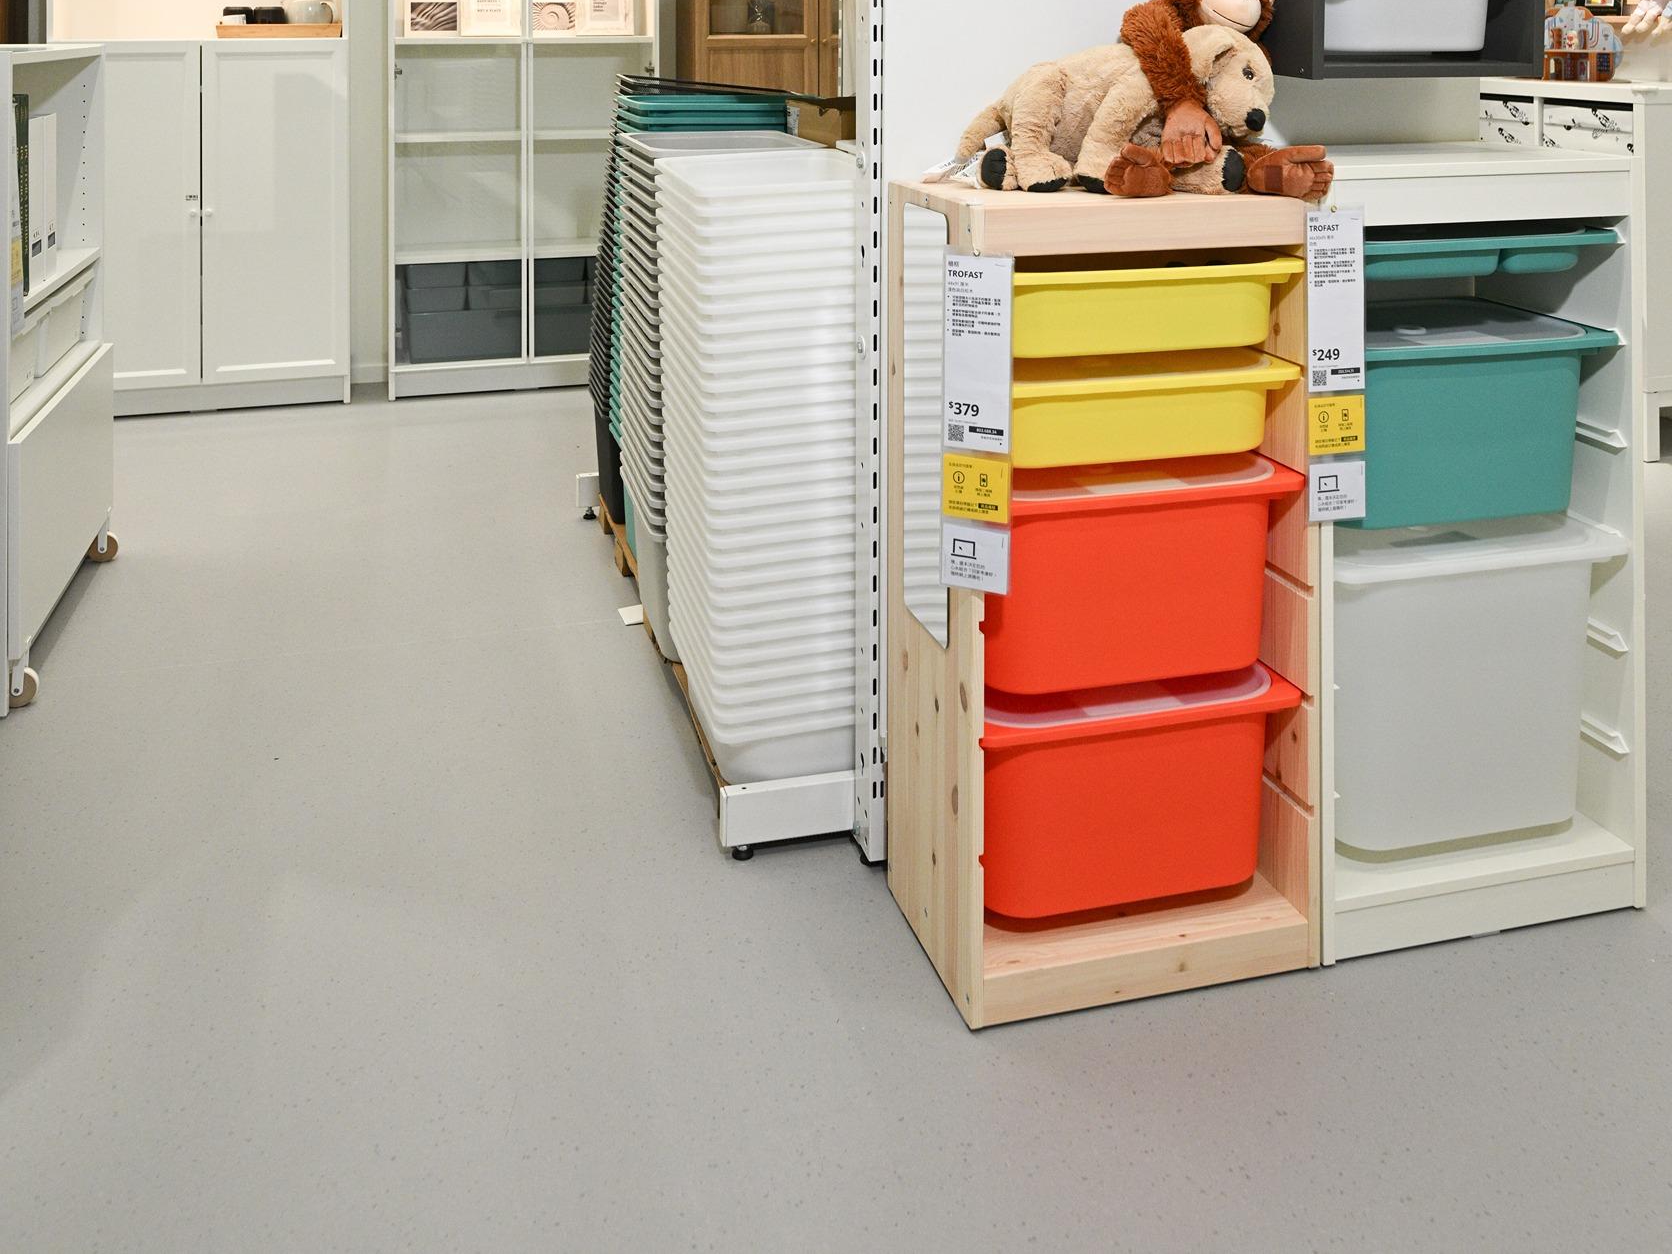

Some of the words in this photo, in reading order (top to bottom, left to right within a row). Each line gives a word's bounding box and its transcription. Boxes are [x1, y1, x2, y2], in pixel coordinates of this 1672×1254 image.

[1309, 224, 1340, 232] TROFAST
[947, 269, 984, 279] TROFAST
[1312, 348, 1340, 362] $249
[948, 401, 980, 417] $379
